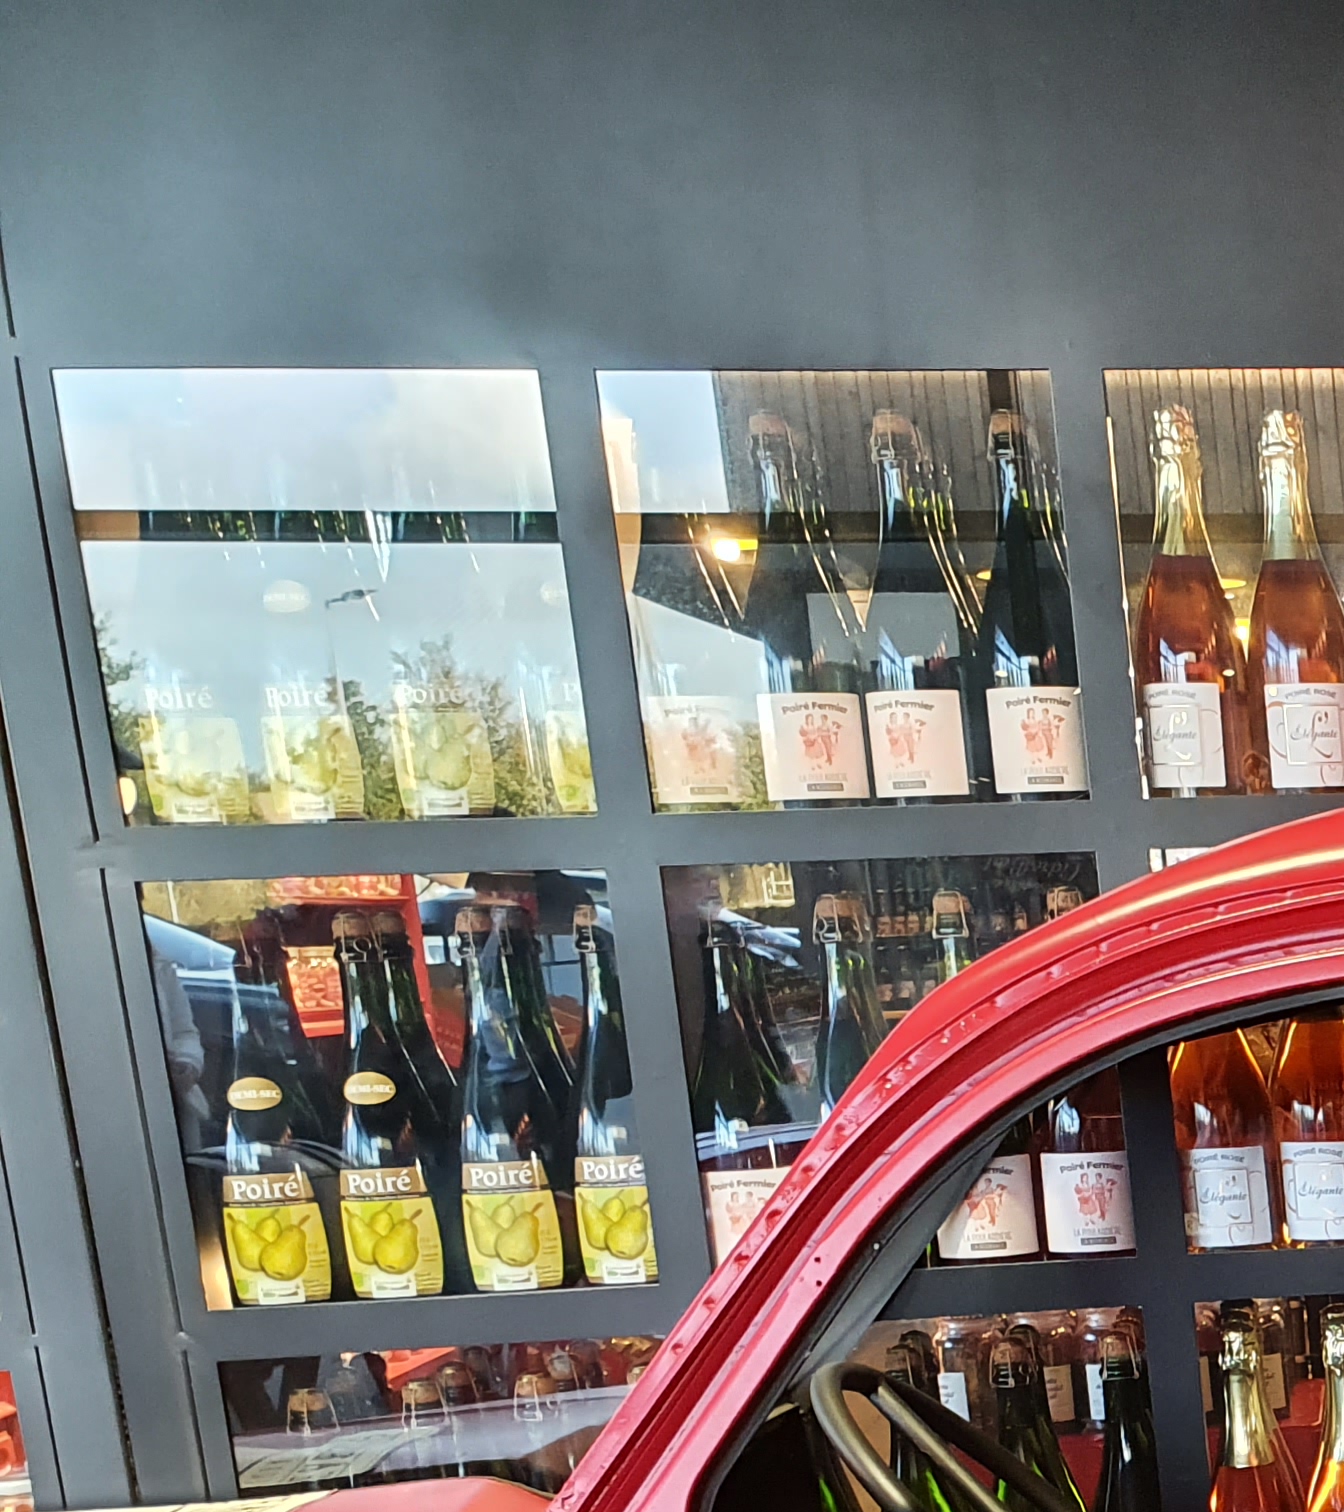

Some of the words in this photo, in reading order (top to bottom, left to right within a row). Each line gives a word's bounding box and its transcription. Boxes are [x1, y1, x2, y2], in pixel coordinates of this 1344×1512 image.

[144, 685, 214, 710] Poiré
[265, 681, 332, 710] Poiré
[469, 1163, 534, 1188] Poiré
[582, 1155, 646, 1182] Poiré
[231, 1175, 300, 1202] Poiré
[347, 1169, 413, 1196] Poiré
